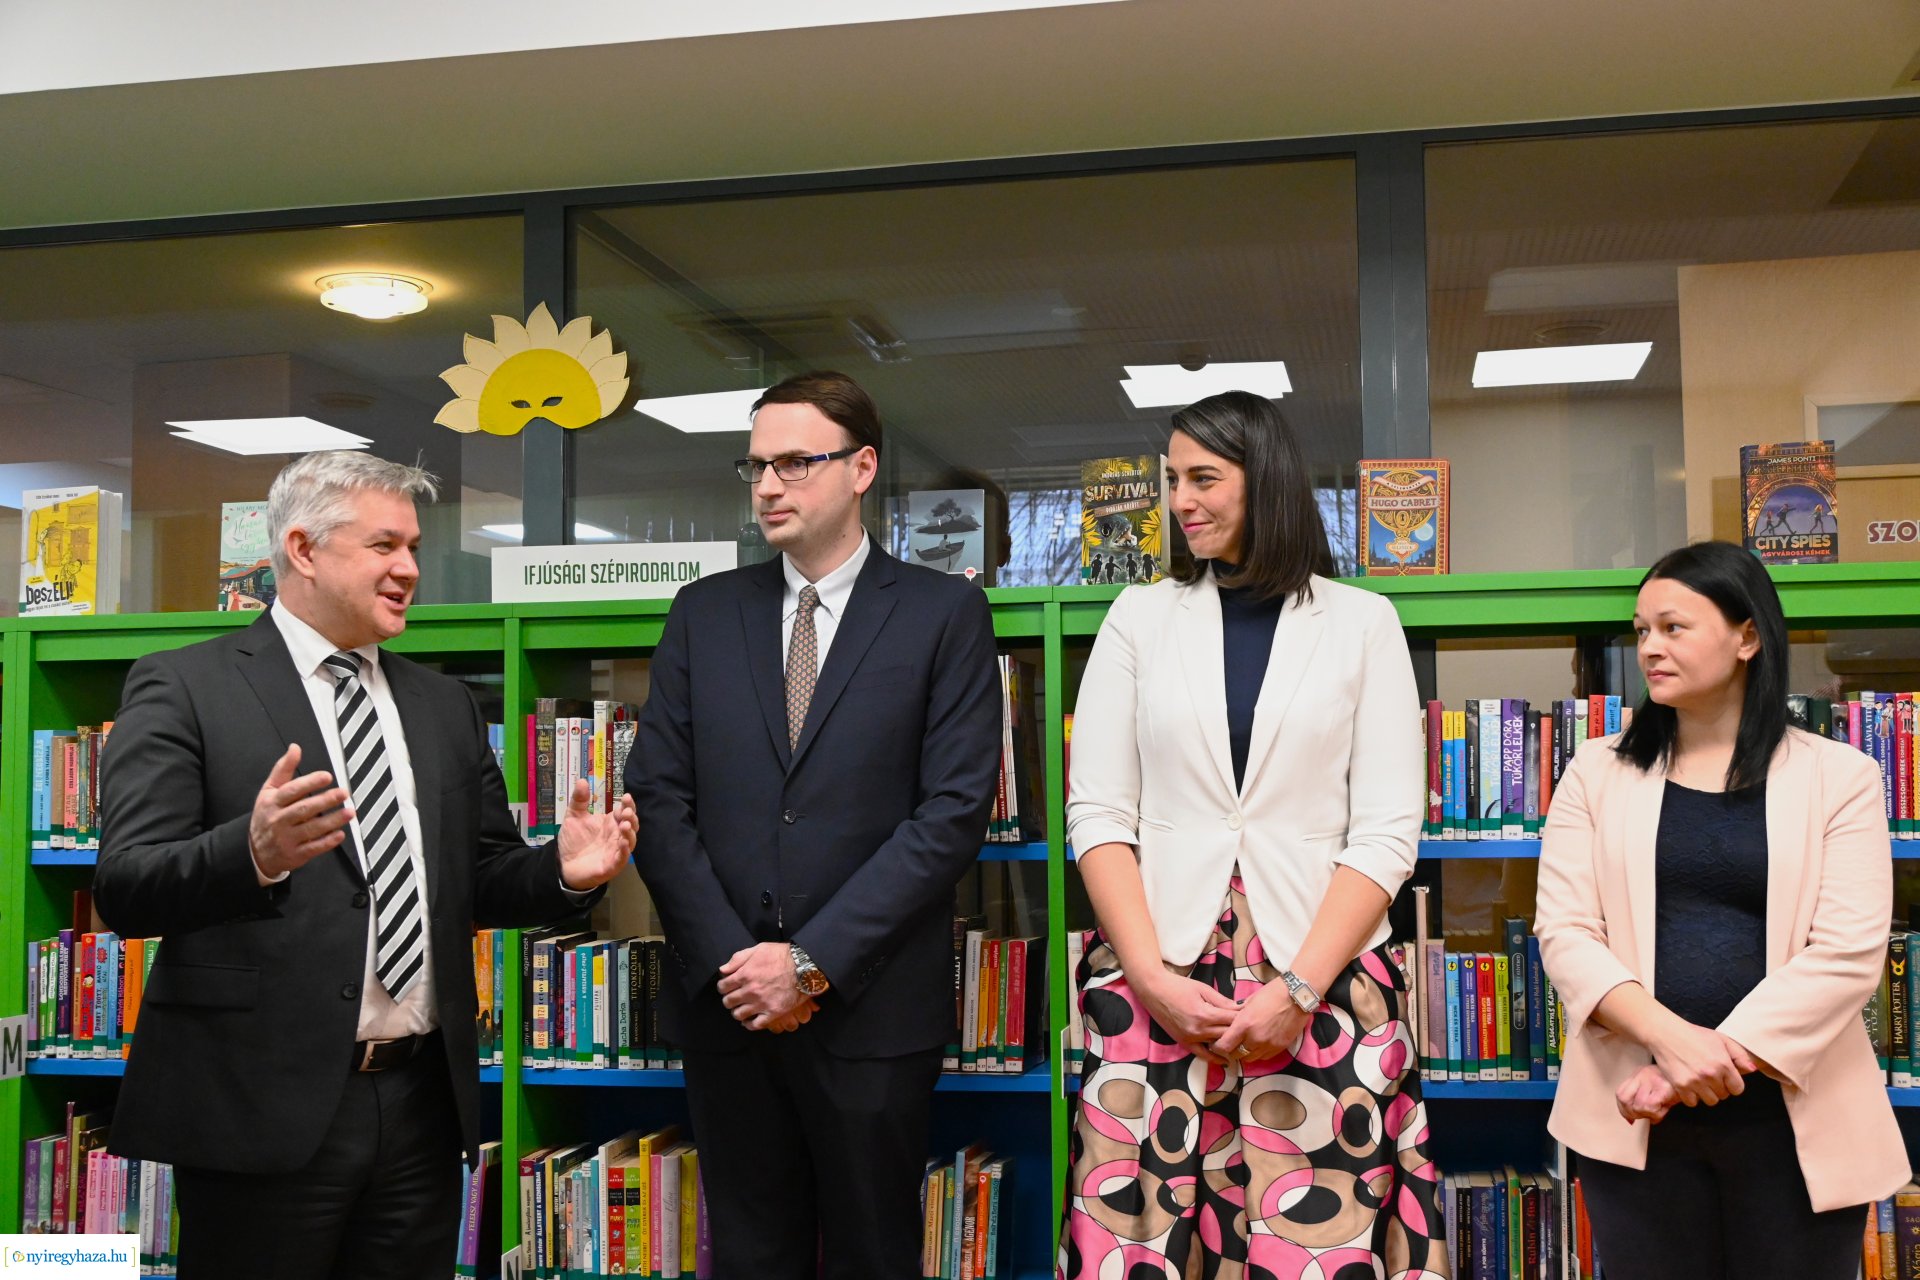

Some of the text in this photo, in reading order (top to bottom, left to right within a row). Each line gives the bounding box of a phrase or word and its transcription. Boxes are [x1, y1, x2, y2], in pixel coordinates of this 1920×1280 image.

[1767, 456, 1791, 464] JAMES
[1084, 481, 1158, 503] SURVIVAL
[1371, 497, 1437, 507] HUGO CABRET
[1755, 534, 1831, 550] CITY SPIES
[1867, 520, 1920, 544] SZO
[1761, 549, 1804, 559] AGYVÁROSI
[524, 558, 700, 585] IFJÚSÁGI SZÉPIRODALOM
[1481, 720, 1490, 773] PAPP DÓRA
[1502, 719, 1513, 772] PAPP DÓRA
[1511, 715, 1523, 786] TÜKÖRLELKEK
[1865, 724, 1873, 757] NALÁVIA
[630, 949, 638, 1001] TITOKFÖLDE
[649, 948, 657, 1000] TITOKFÖLDE
[536, 968, 545, 1047] AUSCHWITZI tetováló
[1891, 980, 1903, 1044] HARRY POTTER
[1549, 1007, 1557, 1048] ALSÓGATYÁS
[2, 1024, 22, 1075] M
[469, 1187, 478, 1204] VAGY
[1882, 1203, 1892, 1218] fia
[468, 1205, 477, 1232] FELELSZ
[1528, 1232, 1537, 1264] Rubin
[1887, 1220, 1895, 1268] szerencse
